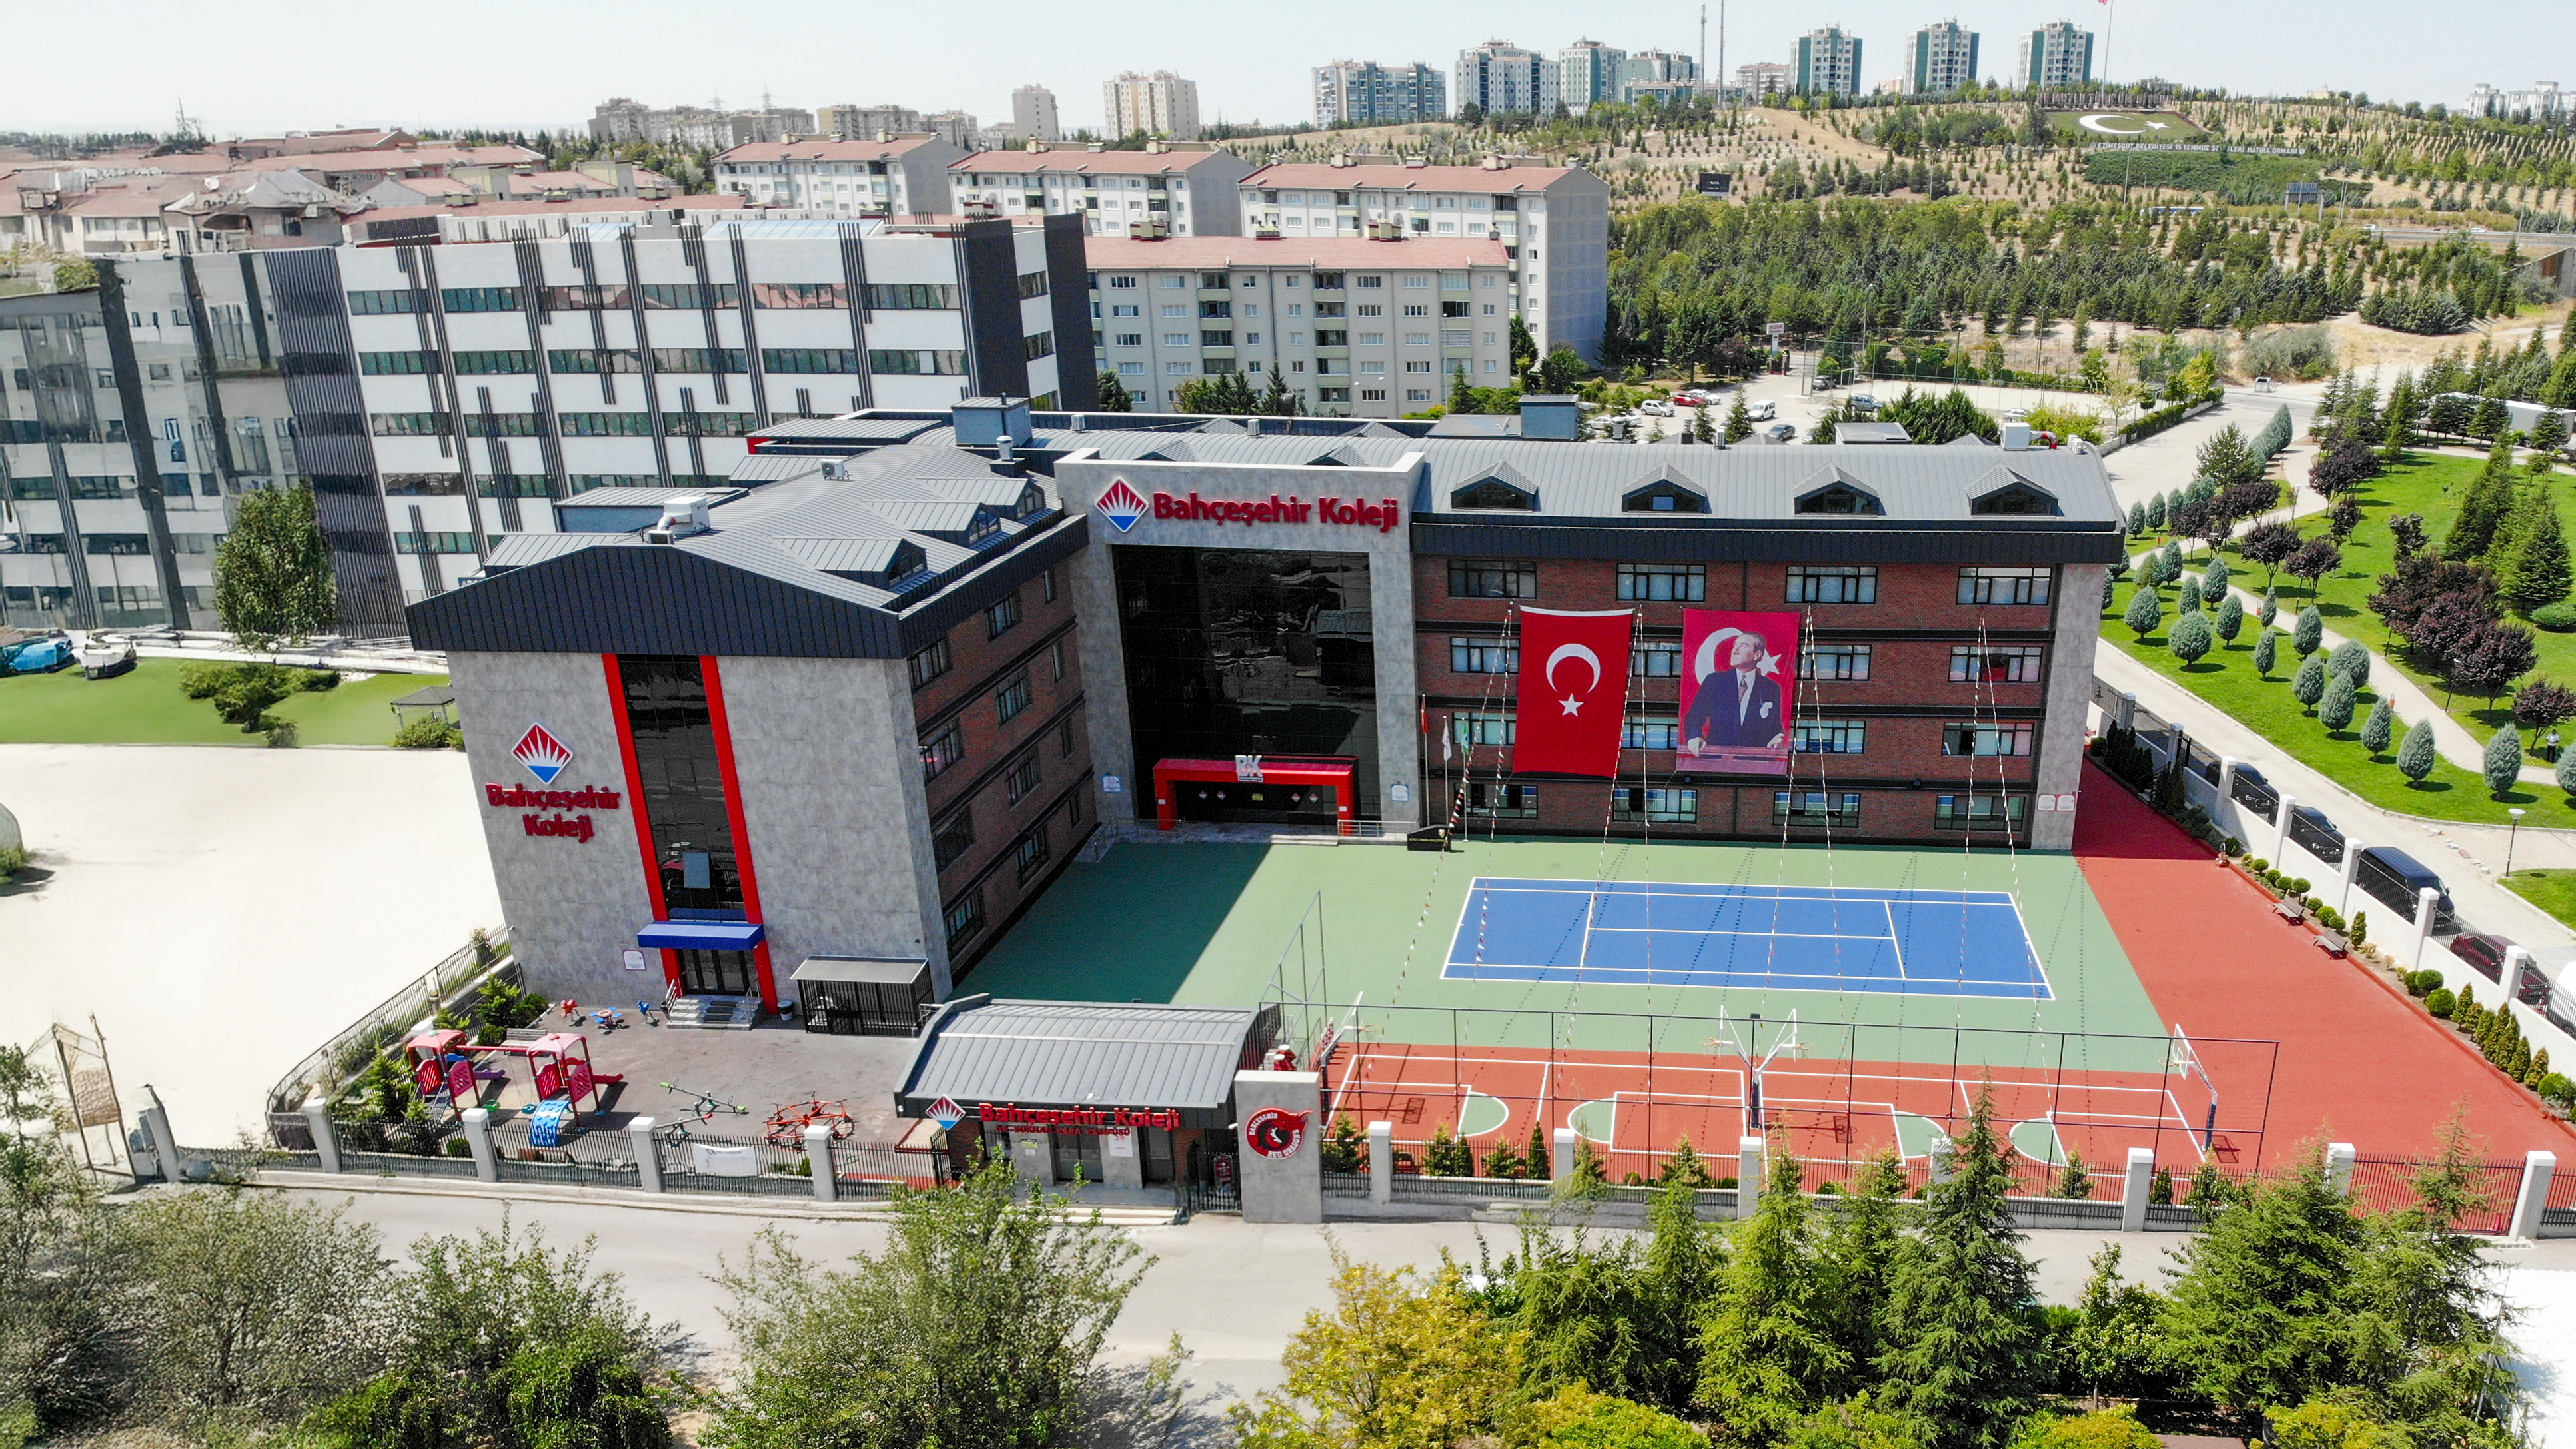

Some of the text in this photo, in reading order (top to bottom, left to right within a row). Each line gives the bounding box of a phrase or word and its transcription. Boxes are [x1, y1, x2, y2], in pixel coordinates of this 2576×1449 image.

[2212, 144, 2244, 153] ŞETLERİ
[1153, 491, 1399, 533] Bahçeşehir Koleji
[485, 783, 620, 811] Bahçeşehir
[522, 813, 594, 843] Koleji
[979, 1102, 1181, 1132] Bahçeşehir Koleji
[1283, 1129, 1301, 1156] DRAGONS
